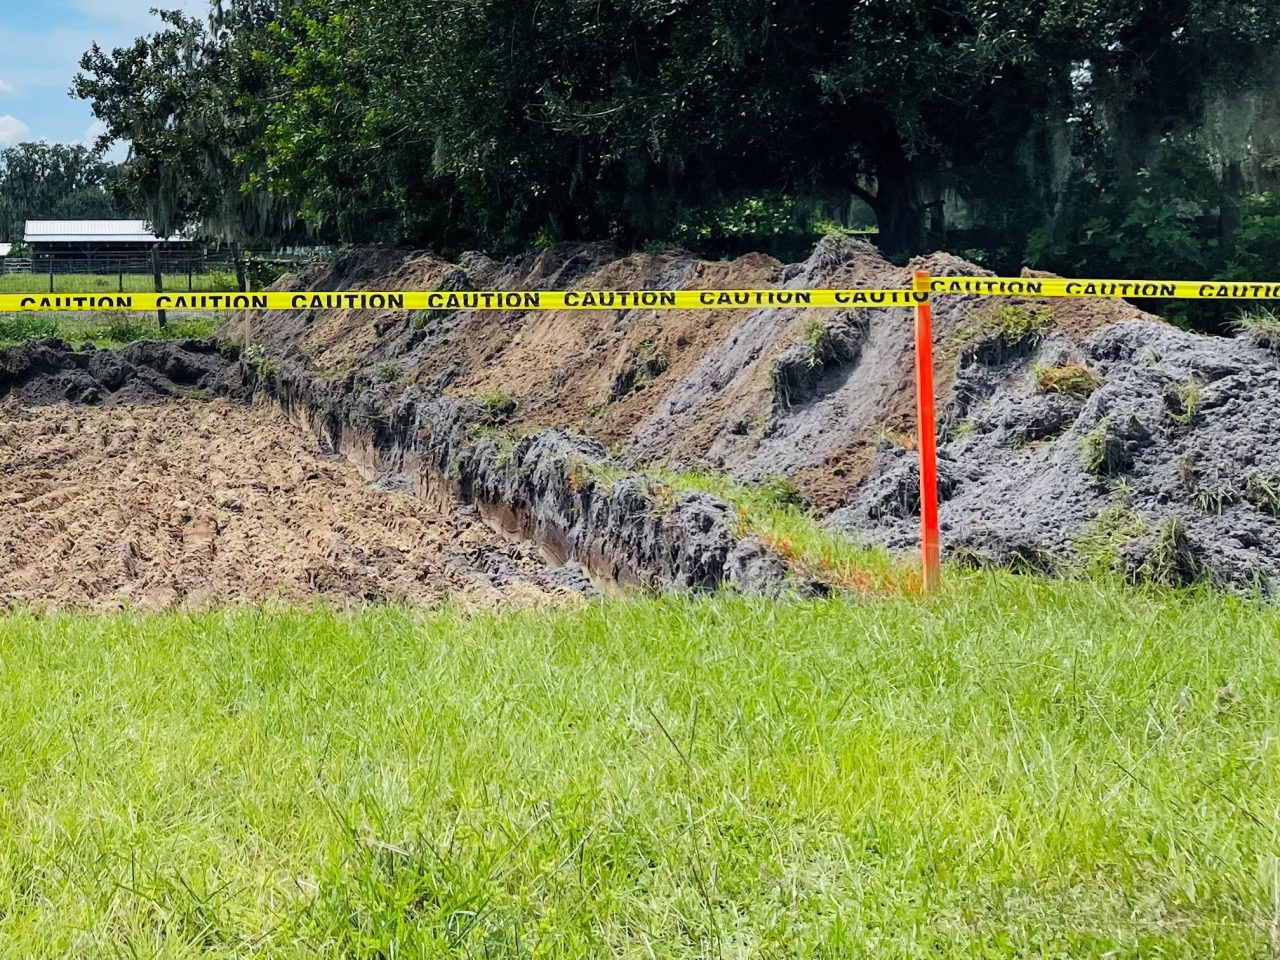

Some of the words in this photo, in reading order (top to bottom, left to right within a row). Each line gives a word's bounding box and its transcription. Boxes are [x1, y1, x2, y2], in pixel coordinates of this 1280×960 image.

[931, 280, 1042, 294] CAUTION
[1066, 283, 1176, 297] CAUTION
[20, 296, 132, 310] CAUTION
[156, 295, 268, 308] CAUTION
[291, 294, 404, 309] CAUTION
[428, 292, 540, 308] CAUTION
[563, 291, 676, 307] CAUTION
[699, 291, 811, 305] CAUTION
